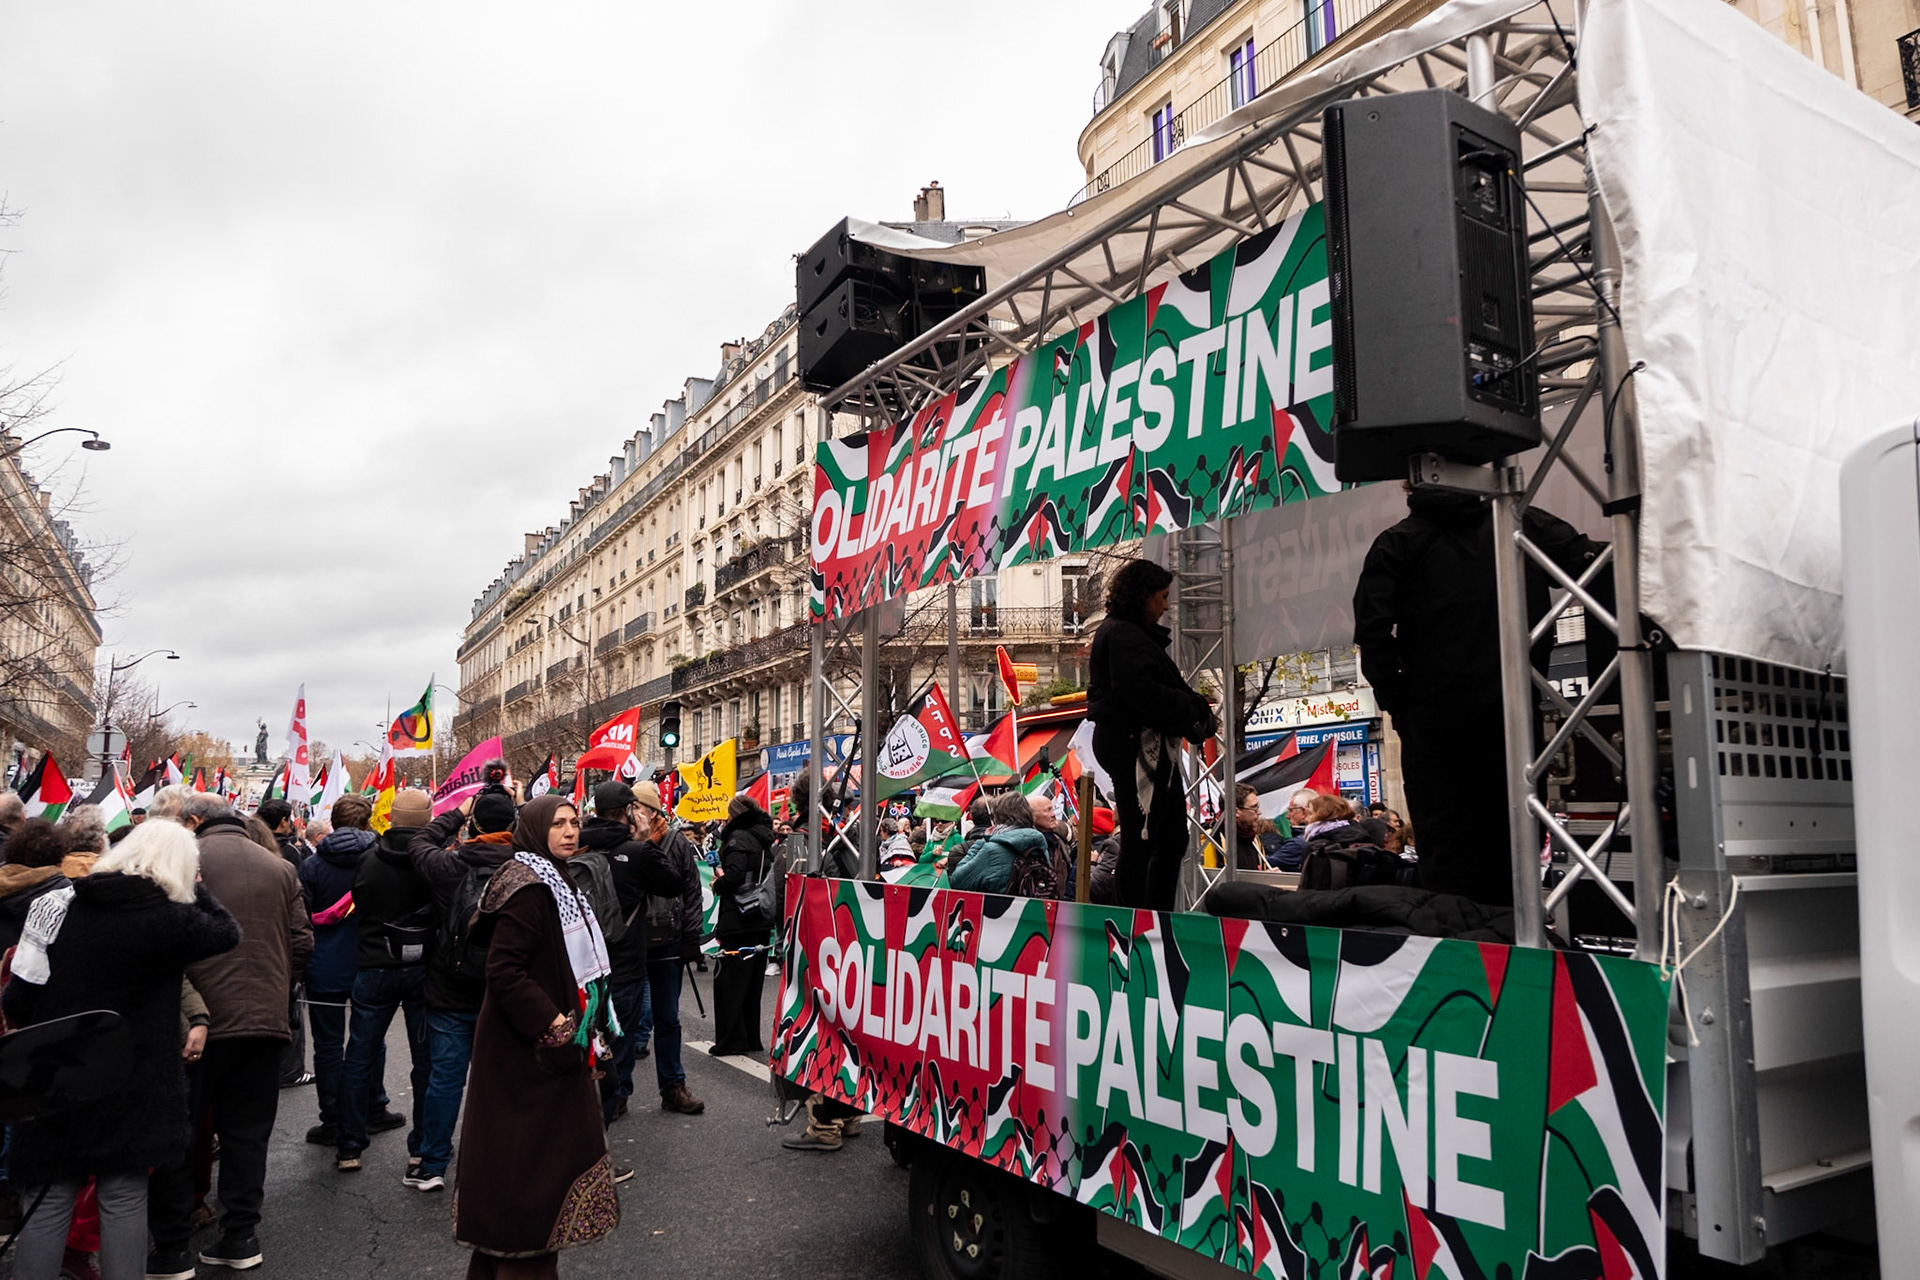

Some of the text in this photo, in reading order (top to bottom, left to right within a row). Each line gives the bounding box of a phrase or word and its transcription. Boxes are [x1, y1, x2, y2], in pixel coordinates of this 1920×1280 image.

[811, 277, 1334, 564] OLIDARITÉ PALESTINE
[1016, 669, 1037, 677] Tabac
[1248, 699, 1359, 726] ONIX Mistepad
[1296, 735, 1320, 745] ERIEL
[818, 936, 1506, 1231] SOLIDARITÉ PALESTINE
